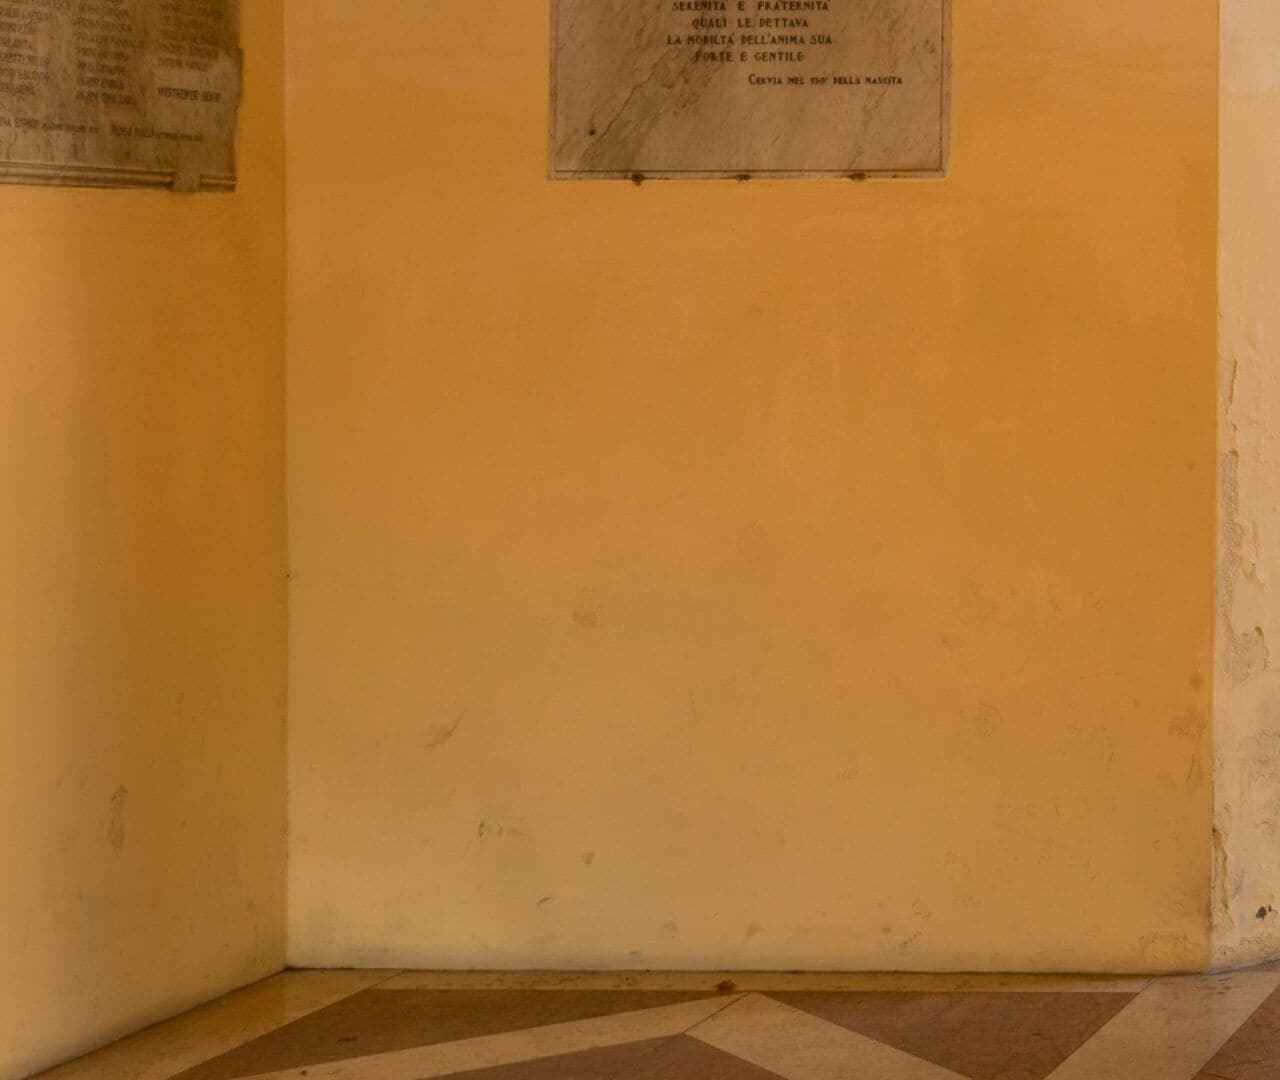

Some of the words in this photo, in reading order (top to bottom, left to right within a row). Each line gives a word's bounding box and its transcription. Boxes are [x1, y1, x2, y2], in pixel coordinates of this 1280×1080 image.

[738, 1, 745, 11] E
[692, 18, 728, 29] QUALI
[738, 18, 752, 28] LE
[759, 18, 808, 28] DETTAVA
[667, 35, 682, 45] LA
[810, 35, 832, 45] SUA
[695, 51, 733, 62] FORTE
[741, 51, 747, 62] E
[754, 51, 804, 62] GENTILE
